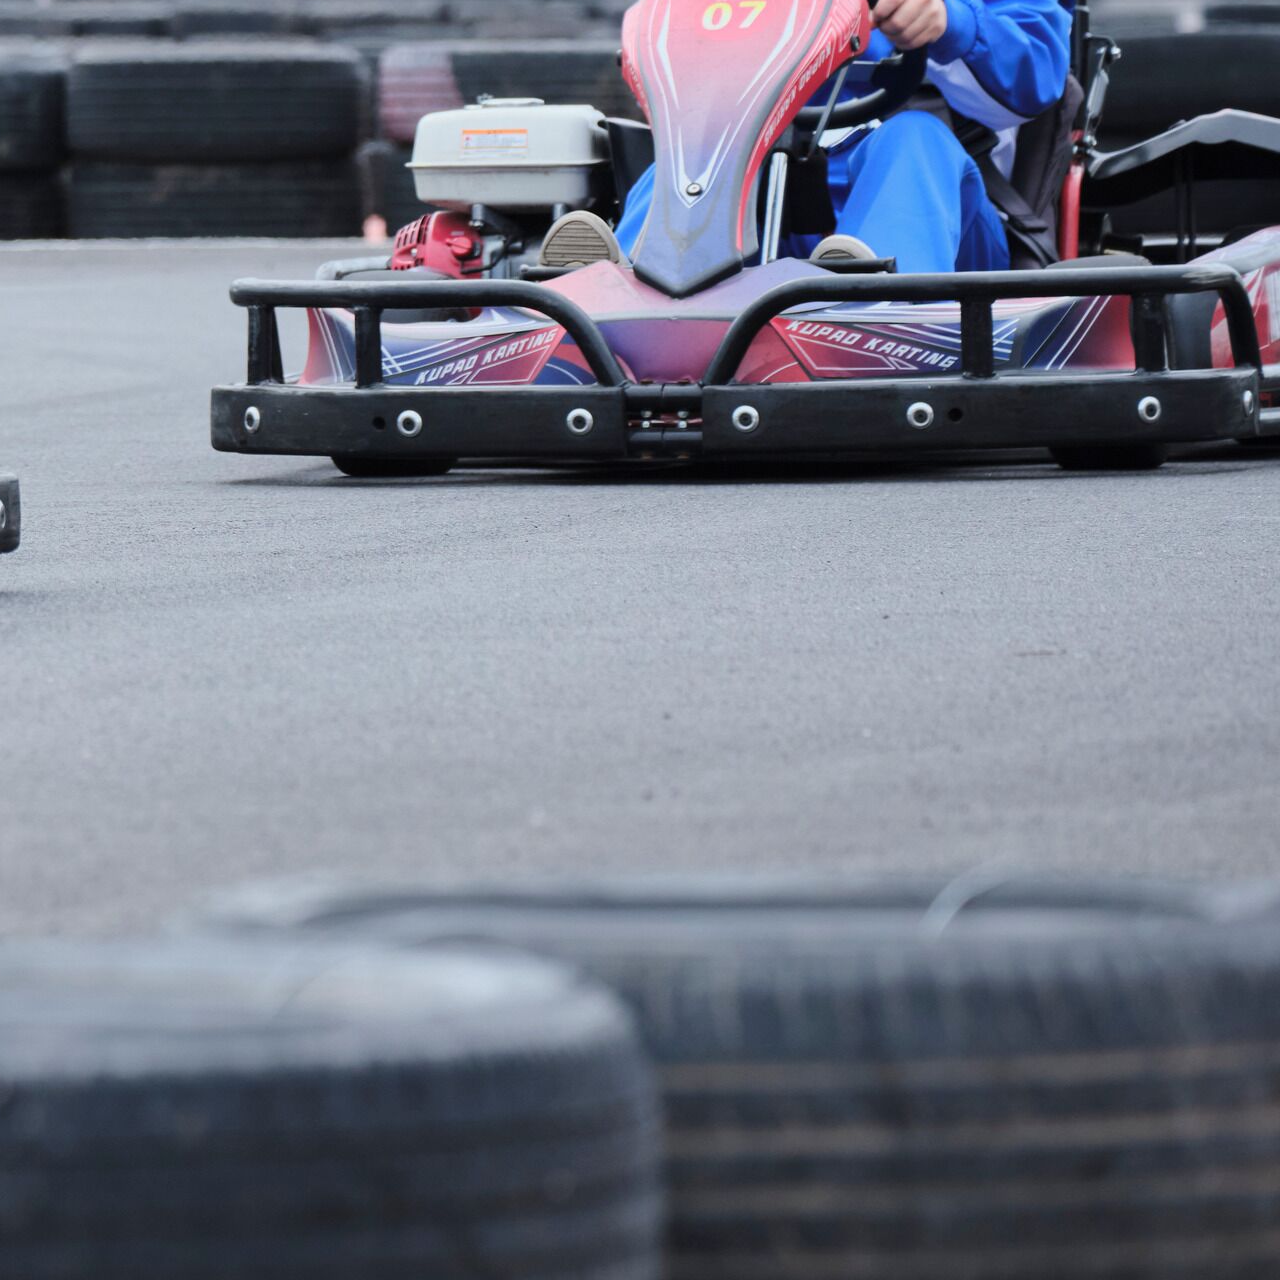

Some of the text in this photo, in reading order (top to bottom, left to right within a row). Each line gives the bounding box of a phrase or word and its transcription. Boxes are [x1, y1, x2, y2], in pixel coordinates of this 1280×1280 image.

[702, 0, 767, 31] 07
[480, 327, 561, 366] KARTING
[863, 337, 960, 369] KARTING
